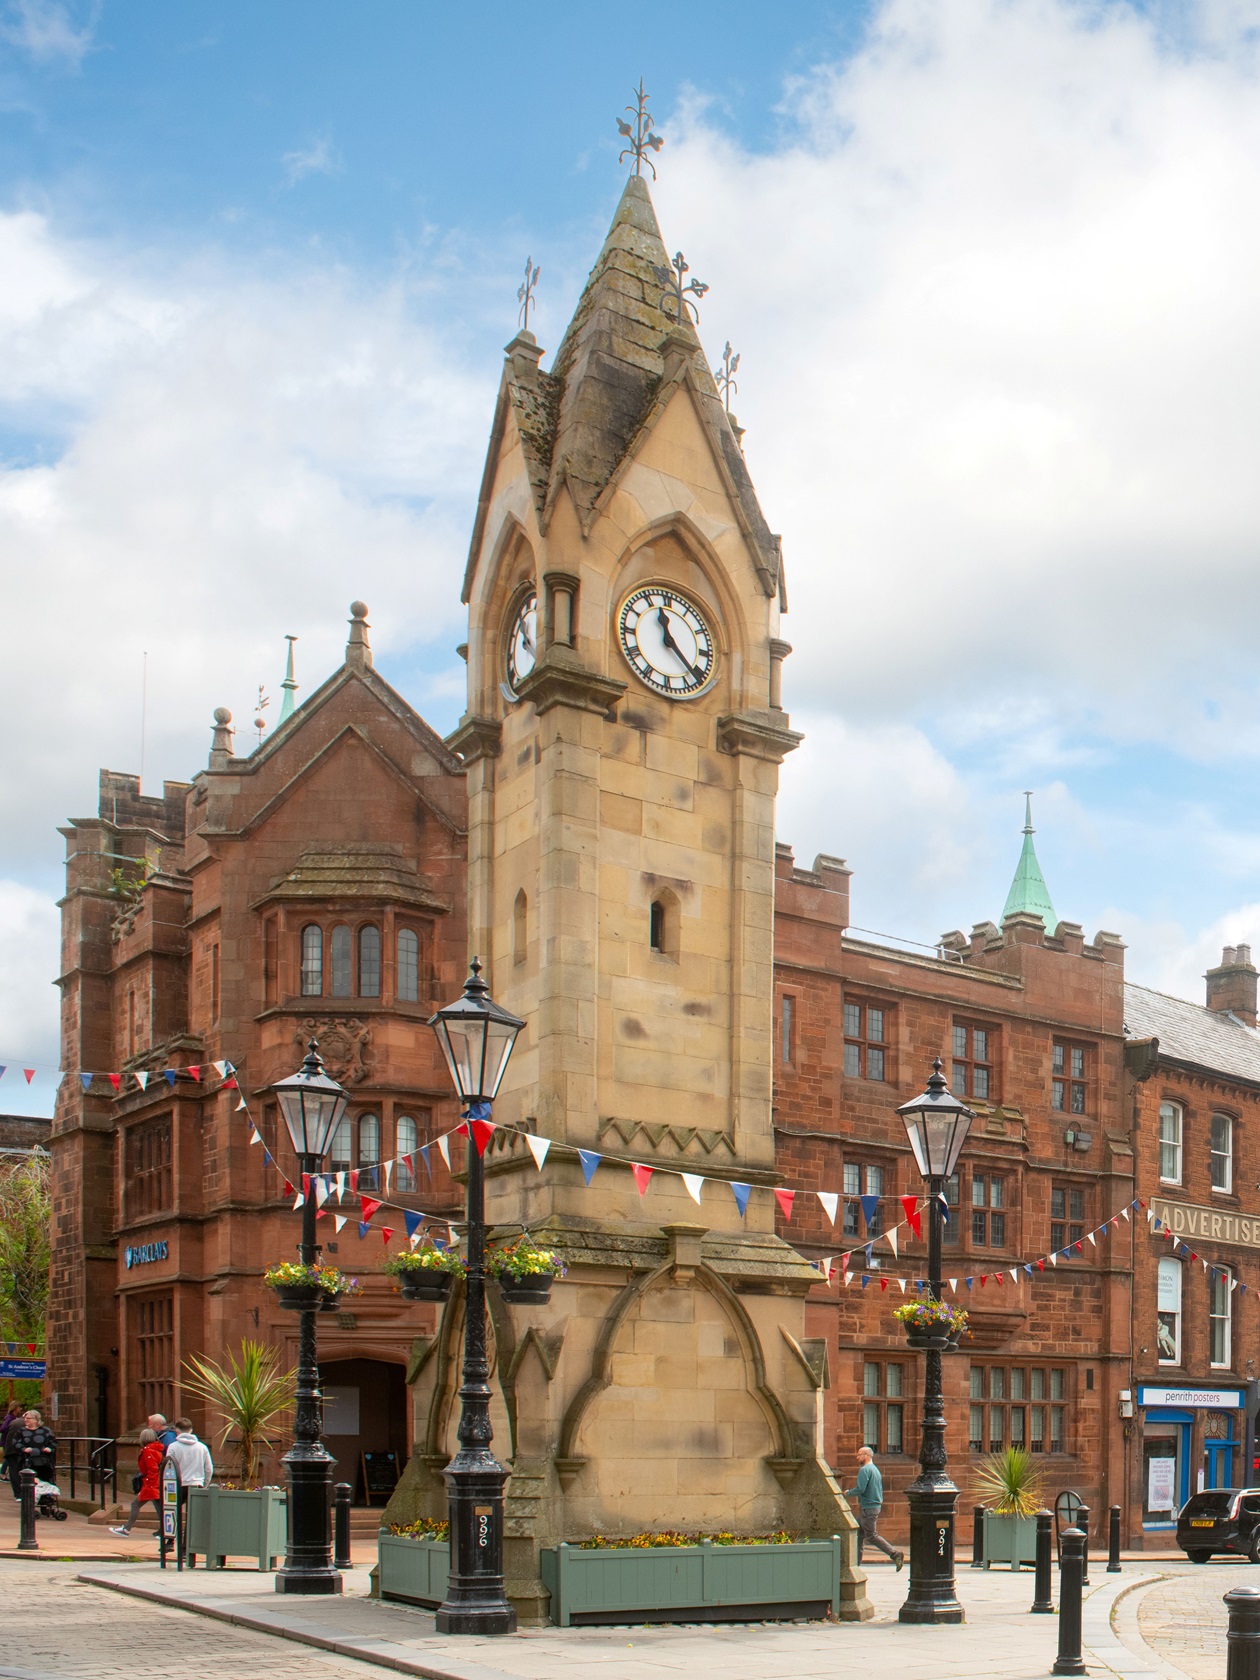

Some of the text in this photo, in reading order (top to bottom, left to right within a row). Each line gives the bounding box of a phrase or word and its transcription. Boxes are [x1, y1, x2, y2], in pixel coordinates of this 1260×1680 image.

[133, 1240, 168, 1265] BARCLAYS
[1165, 1391, 1221, 1404] penrith posters
[479, 1515, 488, 1547] 996
[938, 1528, 946, 1556] 994
